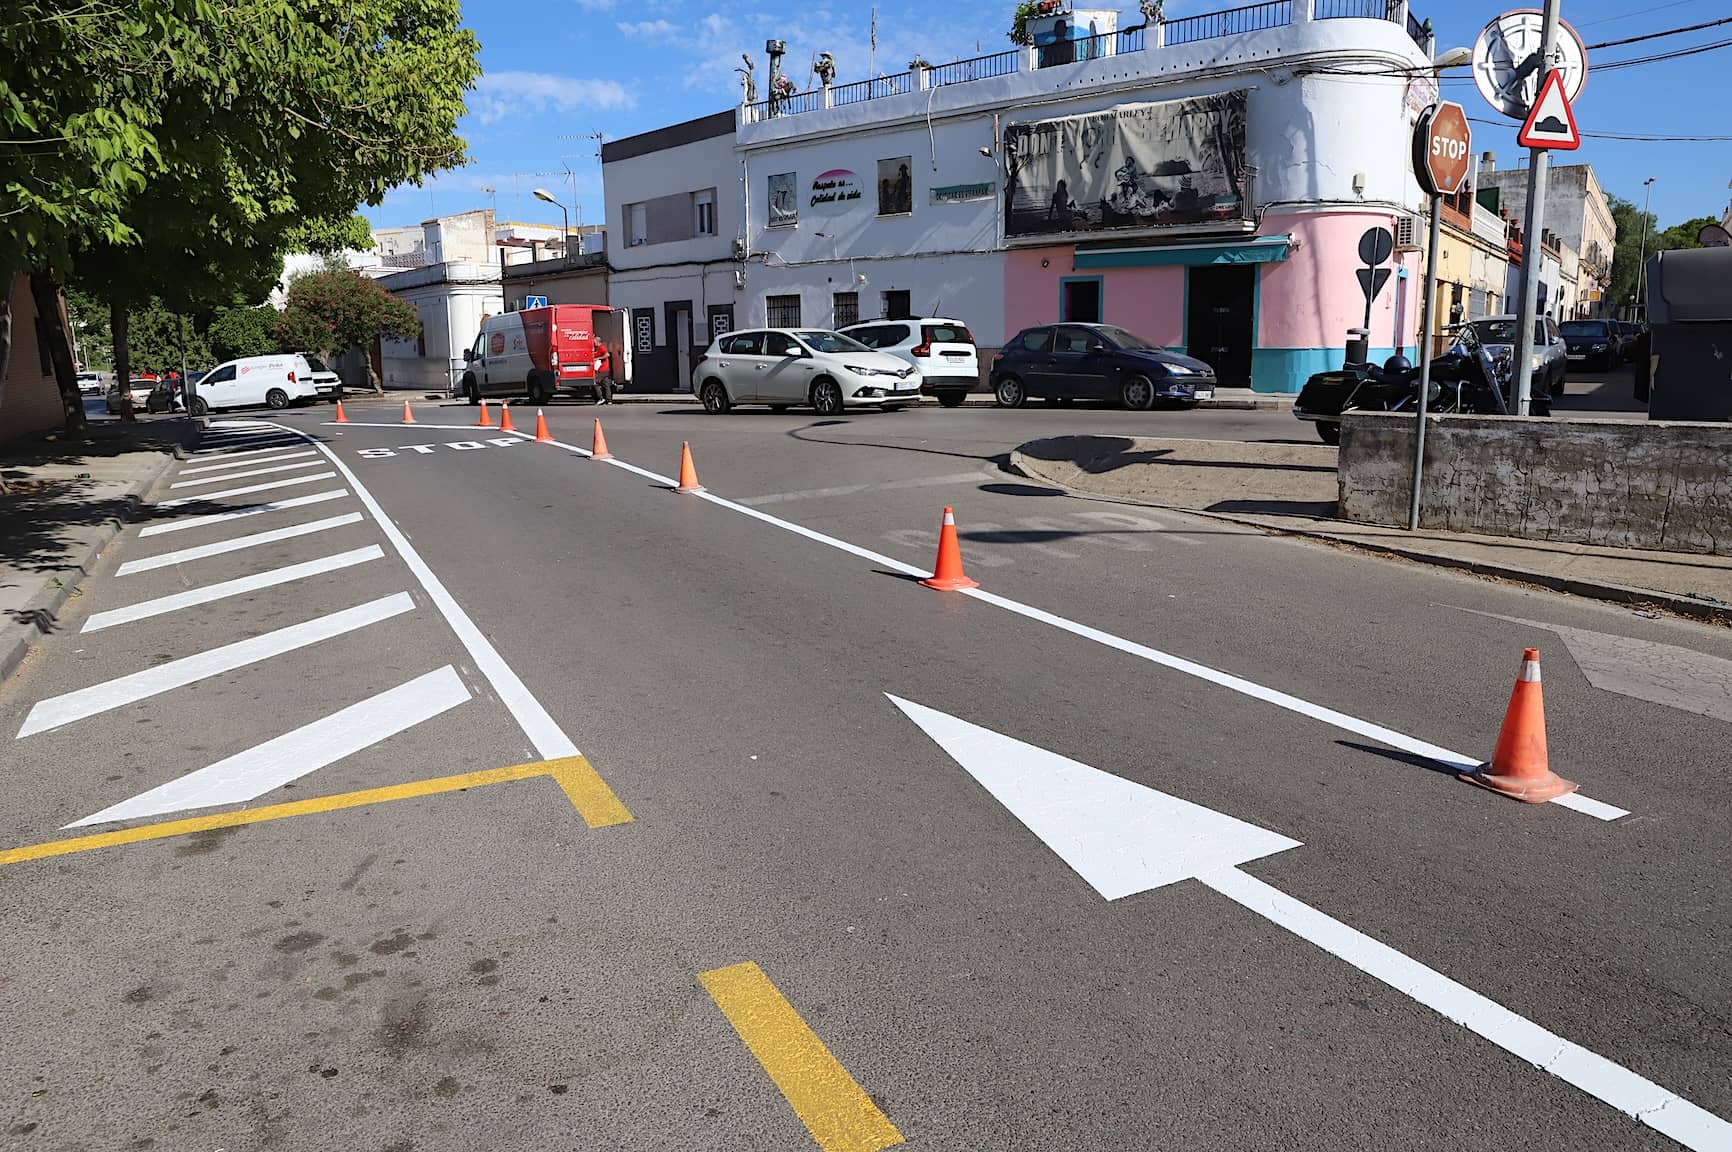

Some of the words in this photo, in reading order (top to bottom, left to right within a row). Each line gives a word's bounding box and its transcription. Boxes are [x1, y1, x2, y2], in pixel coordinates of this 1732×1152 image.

[1164, 108, 1232, 141] HAPPY
[1432, 135, 1467, 161] STOP
[357, 437, 524, 459] STOP
